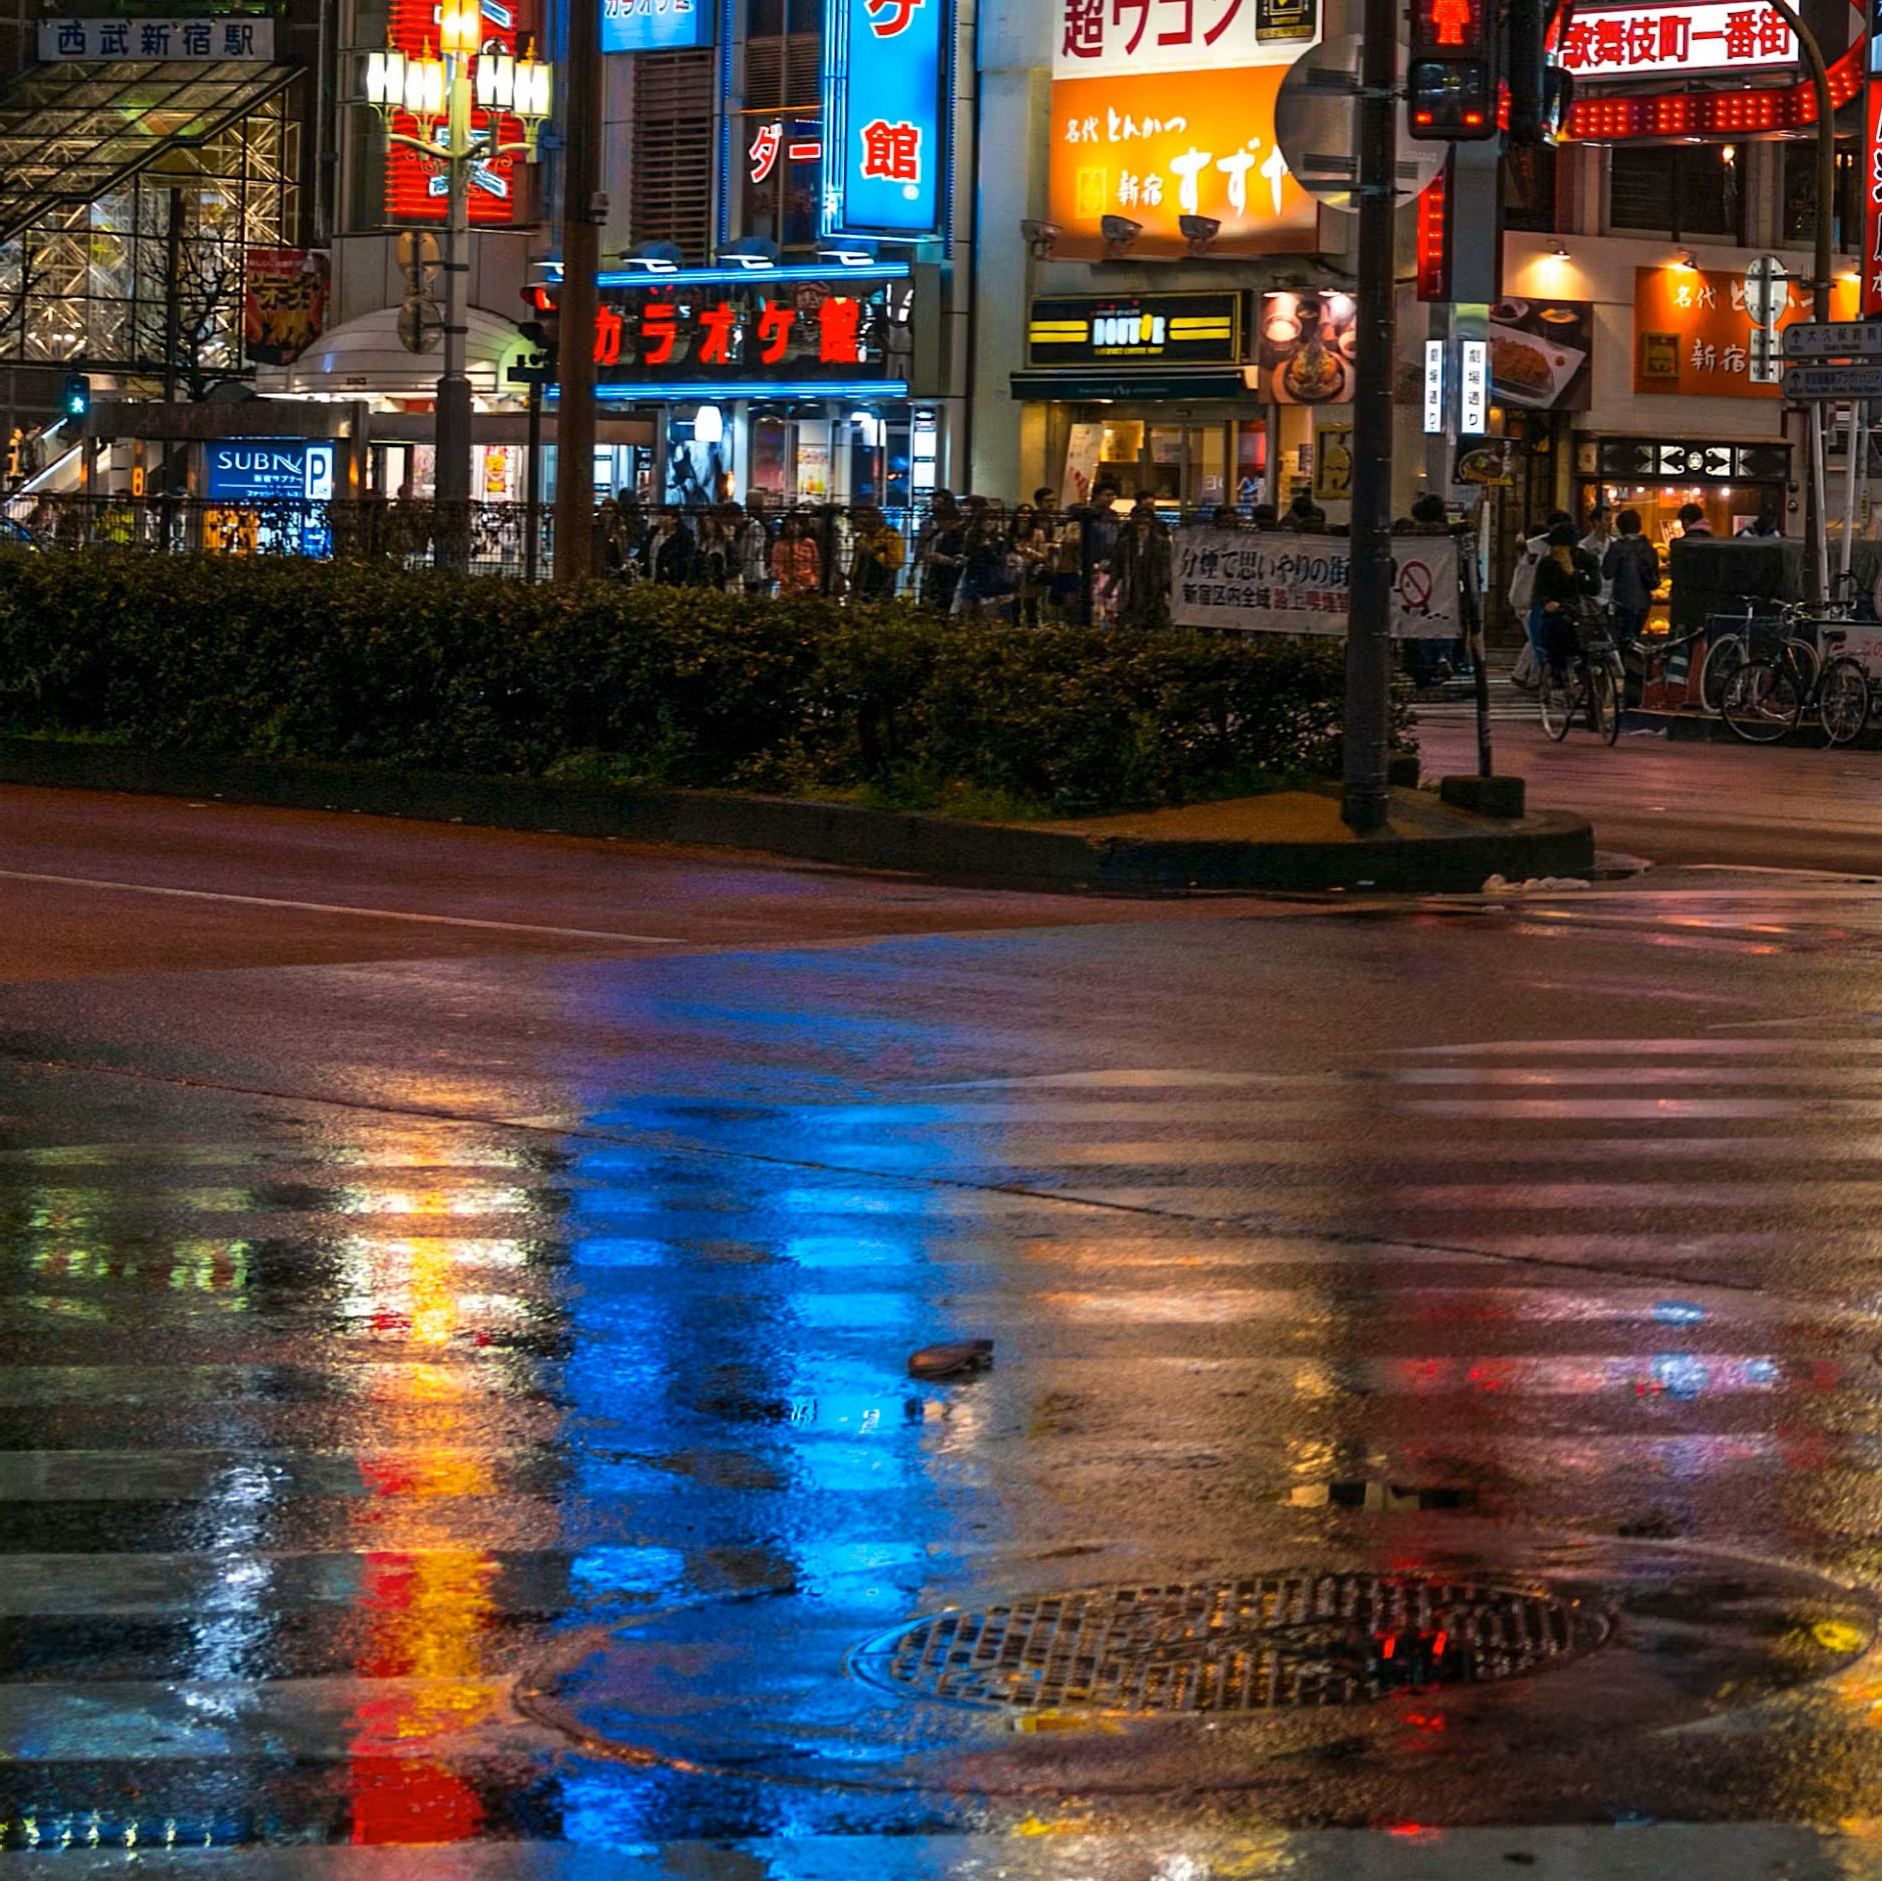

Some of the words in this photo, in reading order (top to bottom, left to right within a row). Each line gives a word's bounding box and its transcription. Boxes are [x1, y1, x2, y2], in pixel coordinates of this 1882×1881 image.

[57, 22, 254, 58] 西武新宿駅
[1562, 6, 1791, 67] 歌舞伎町一番街
[1689, 343, 1746, 374] 新宿
[1179, 546, 1350, 586] 分煙で思いやりの街
